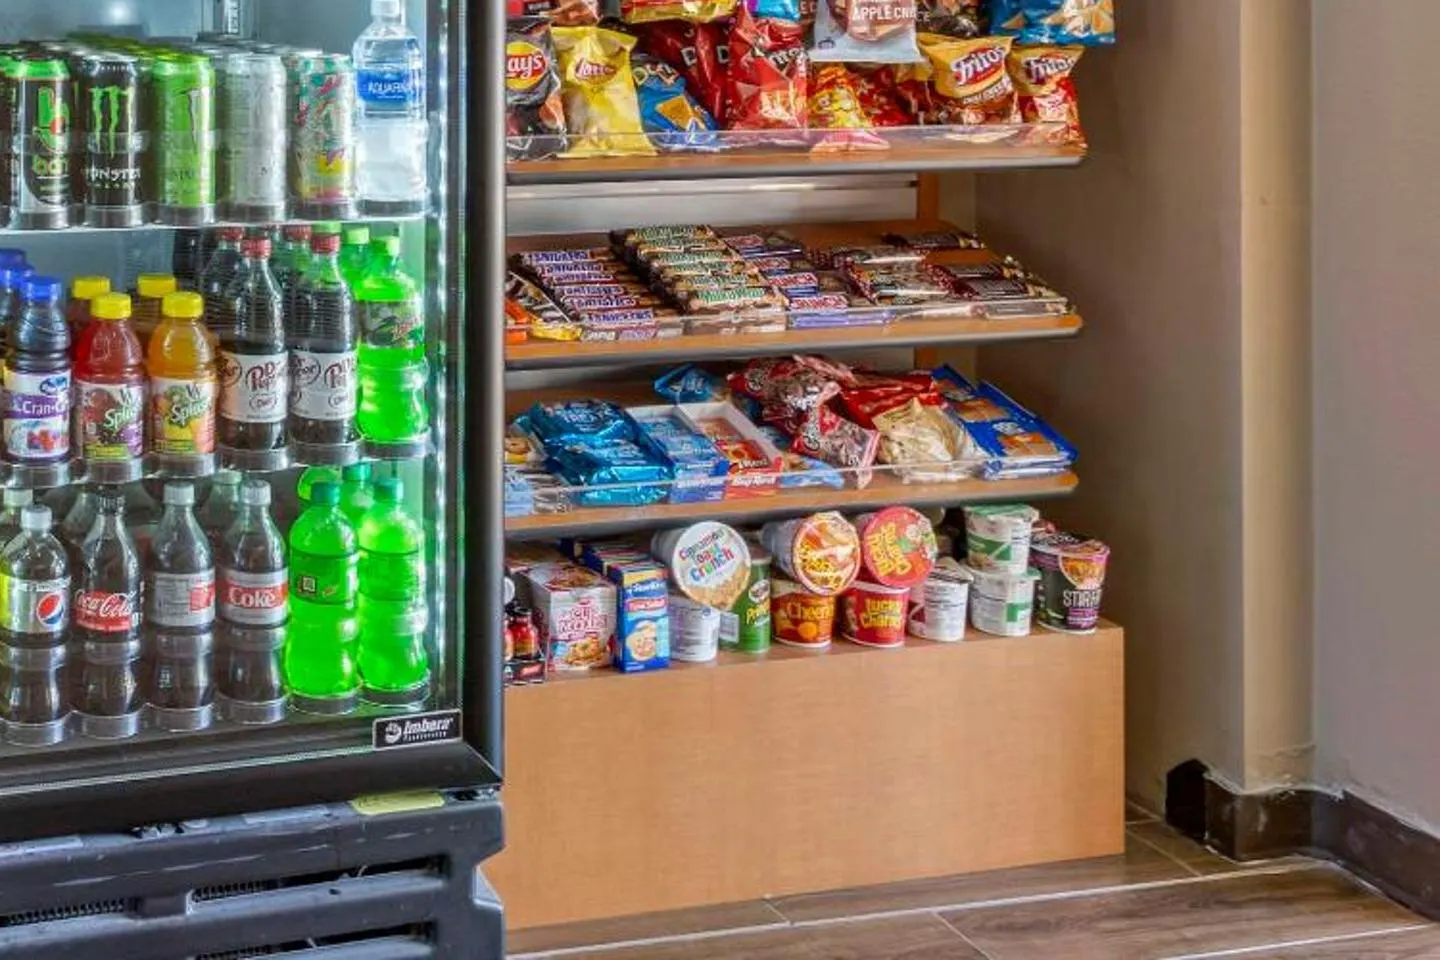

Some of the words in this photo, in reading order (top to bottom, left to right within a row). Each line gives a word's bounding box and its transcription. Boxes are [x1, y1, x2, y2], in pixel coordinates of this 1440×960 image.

[853, 5, 893, 20] APPLE
[507, 51, 543, 79] ay's
[951, 46, 1006, 86] Fritos
[1024, 54, 1076, 83] Fritos
[228, 586, 277, 608] Coke
